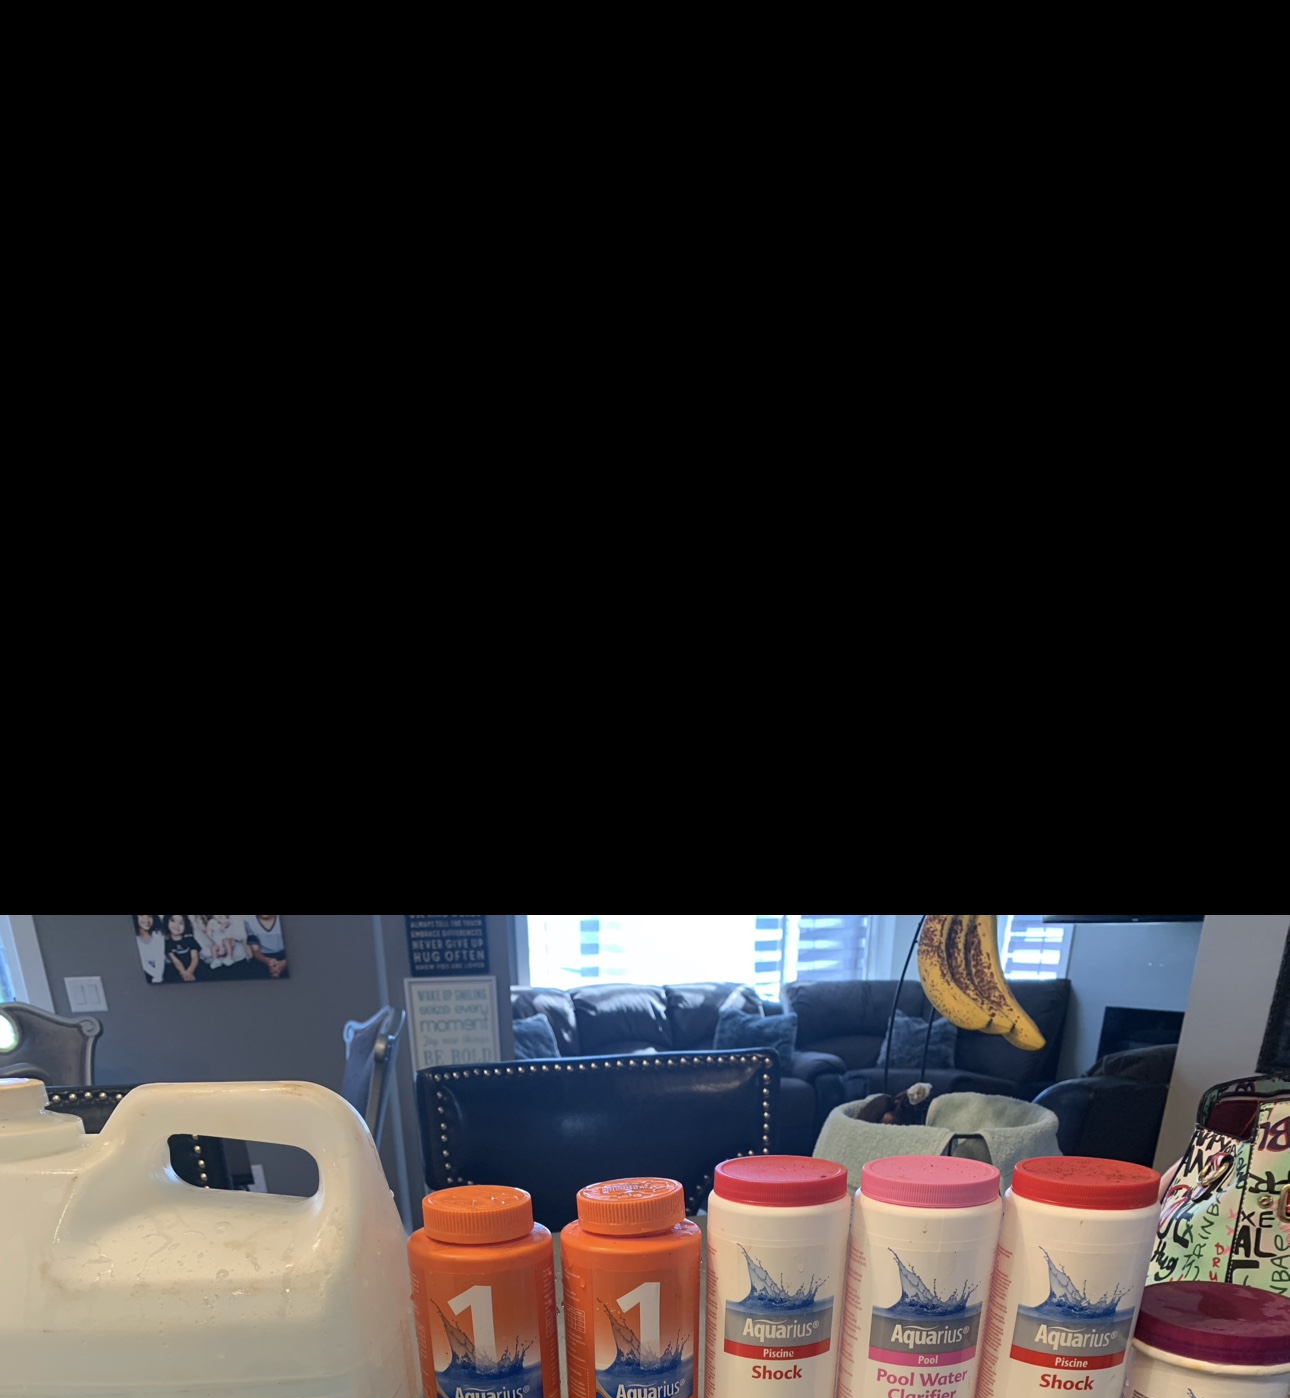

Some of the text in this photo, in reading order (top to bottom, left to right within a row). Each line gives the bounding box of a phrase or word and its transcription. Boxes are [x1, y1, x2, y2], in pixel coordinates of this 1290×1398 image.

[412, 939, 443, 950] NEVER
[445, 938, 468, 949] GIVE
[413, 950, 485, 962] HUG OFTEN
[447, 1285, 497, 1373] 1
[616, 1282, 660, 1369] 1
[763, 1348, 794, 1358] Piscine
[918, 1356, 938, 1365] Pool
[1054, 1357, 1088, 1368] Piscine
[751, 1365, 802, 1380] Shock
[876, 1368, 967, 1387] Pool Water
[1039, 1374, 1094, 1390] Shock
